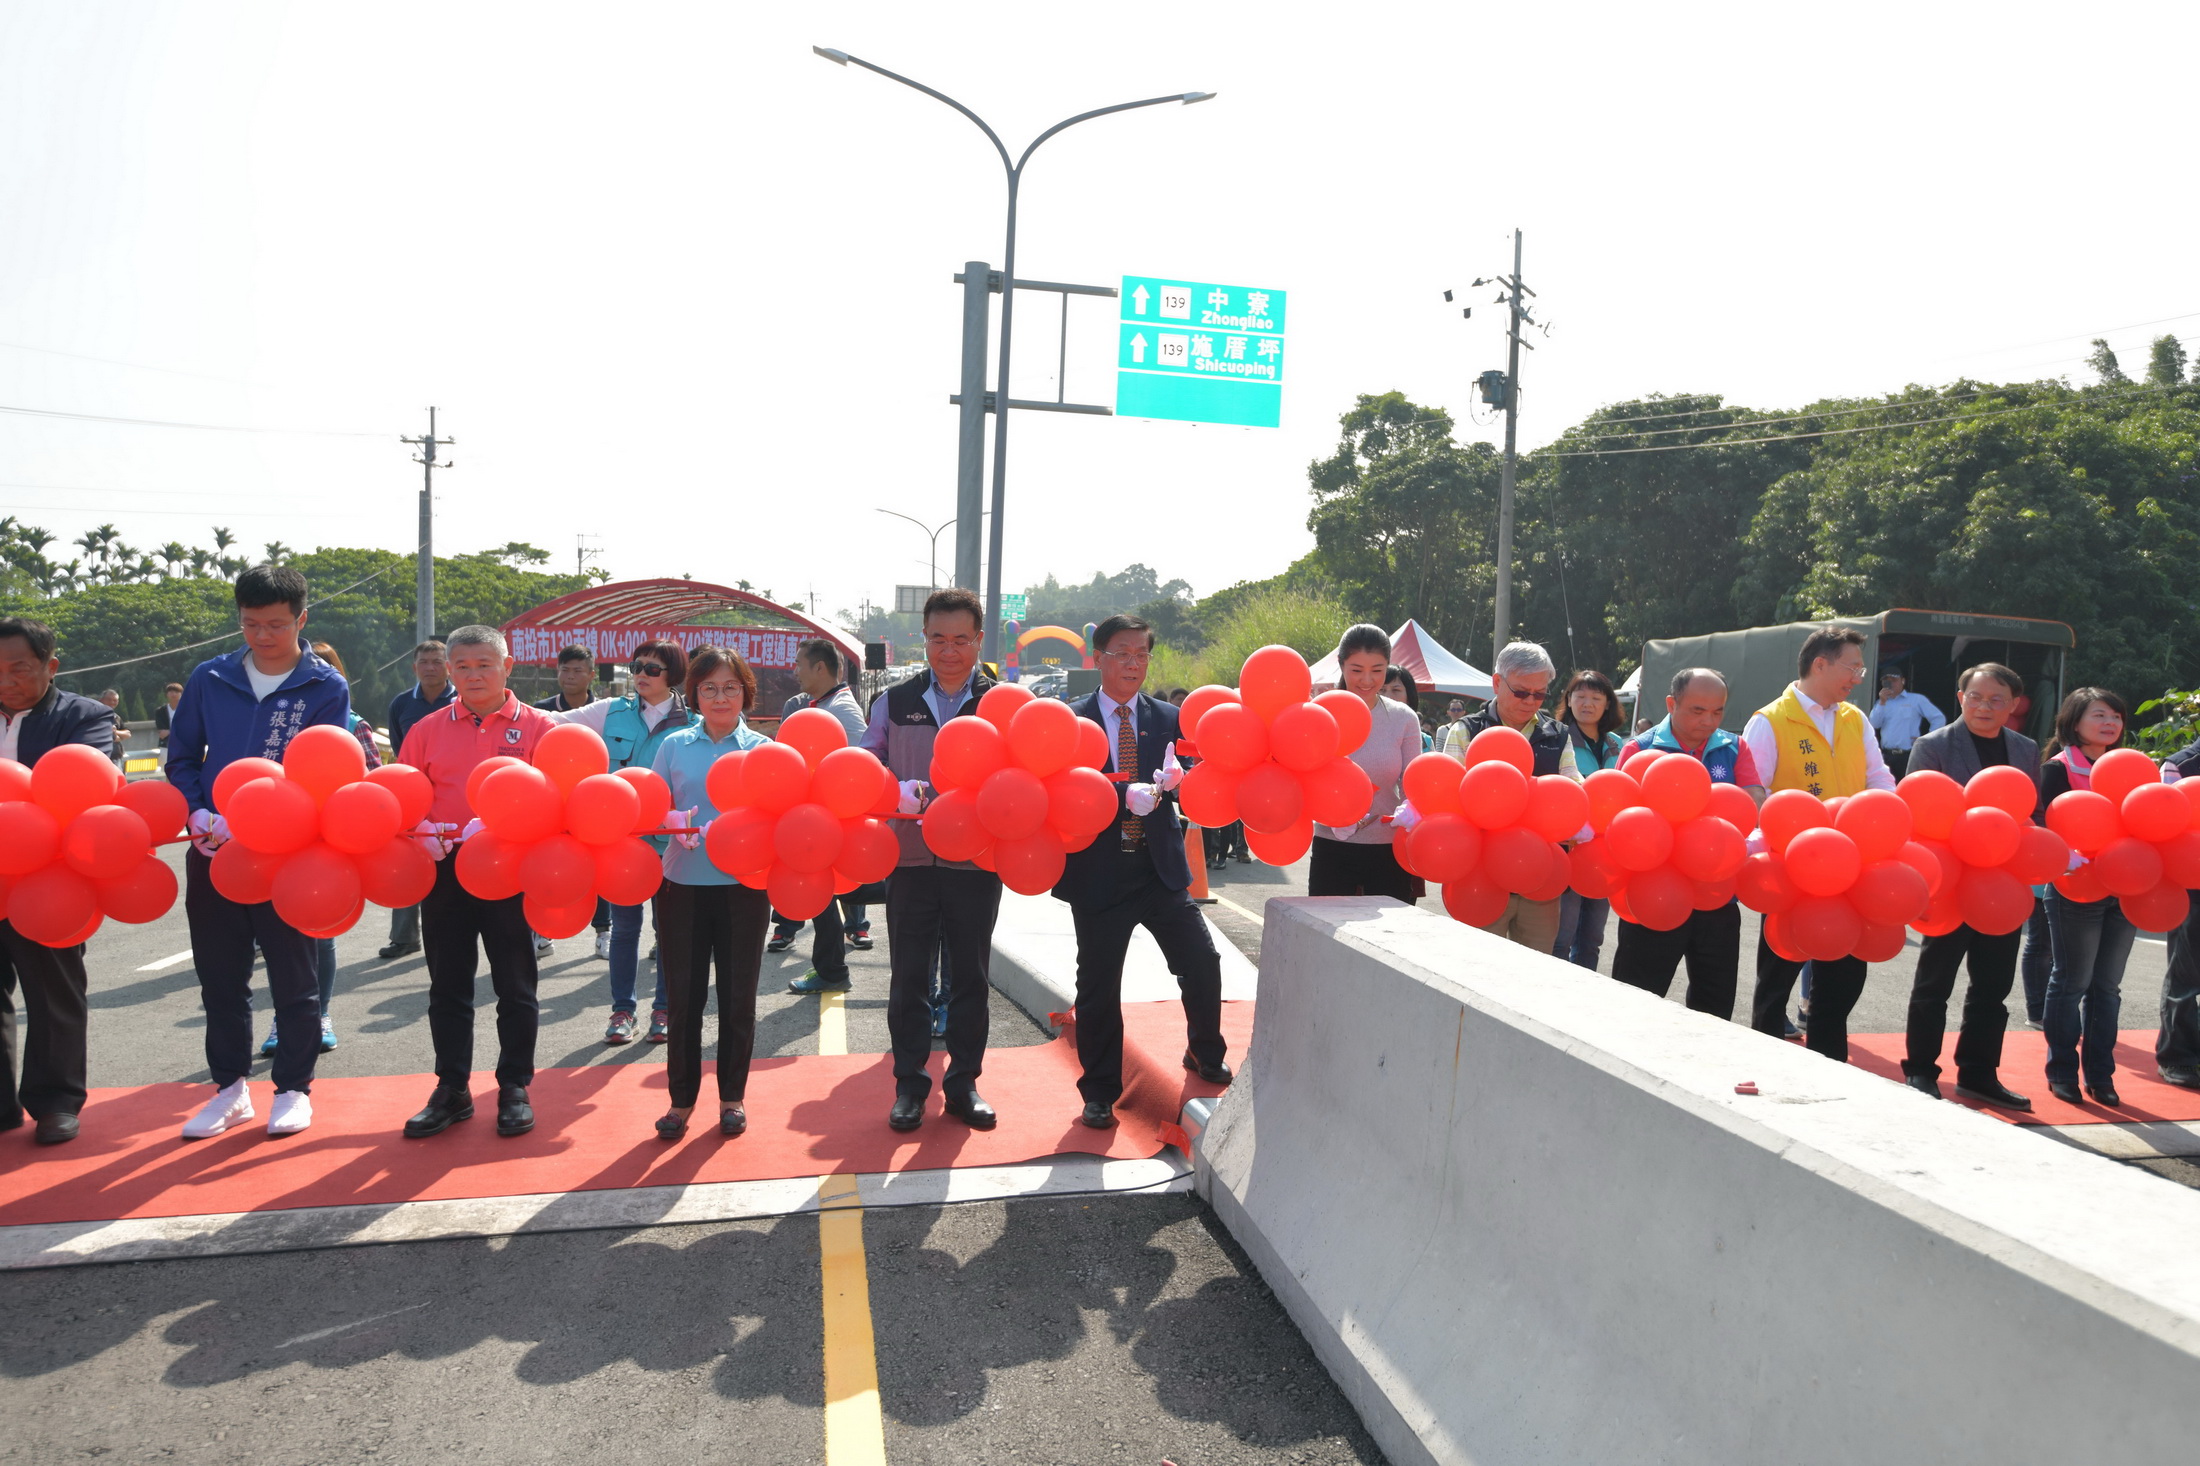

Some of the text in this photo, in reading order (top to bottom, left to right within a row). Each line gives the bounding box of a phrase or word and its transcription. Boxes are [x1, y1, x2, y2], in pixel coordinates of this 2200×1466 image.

[1165, 296, 1186, 309] 139
[1207, 287, 1270, 316] 中寮
[1201, 310, 1274, 331] Zhongliao
[1163, 344, 1184, 356] 139
[1190, 334, 1281, 362] 施厝坪
[1194, 357, 1276, 380] Shicuoping
[508, 731, 519, 740] M
